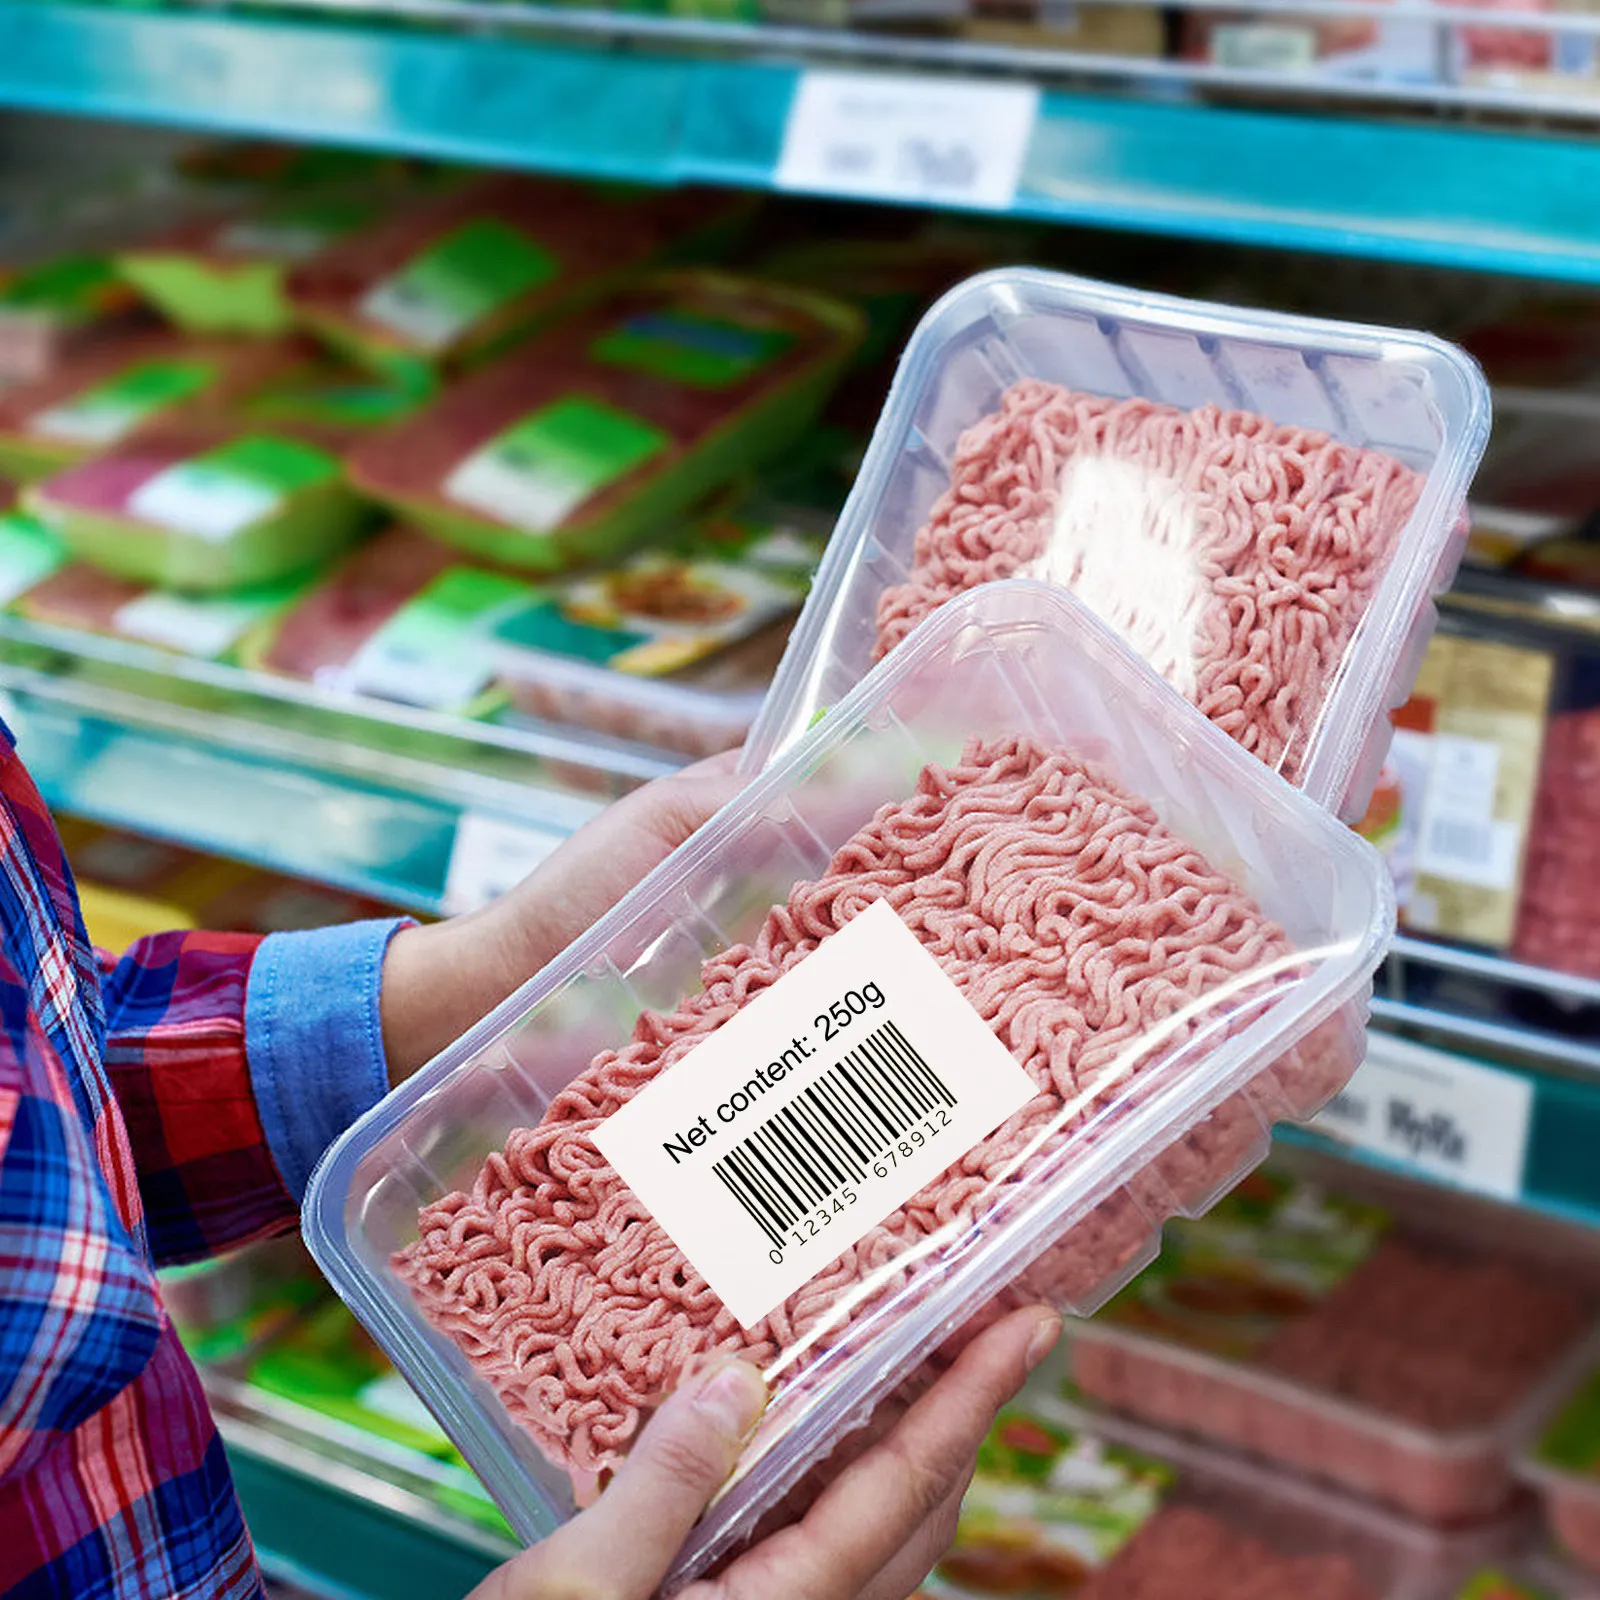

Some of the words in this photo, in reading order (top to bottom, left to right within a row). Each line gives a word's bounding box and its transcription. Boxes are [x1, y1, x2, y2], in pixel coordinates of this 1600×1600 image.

[662, 1115, 717, 1164] Net
[716, 1035, 817, 1122] content:
[814, 981, 886, 1041] 250g
[768, 1249, 784, 1265] 0
[791, 1188, 858, 1247] 12345
[873, 1110, 953, 1179] 678912
